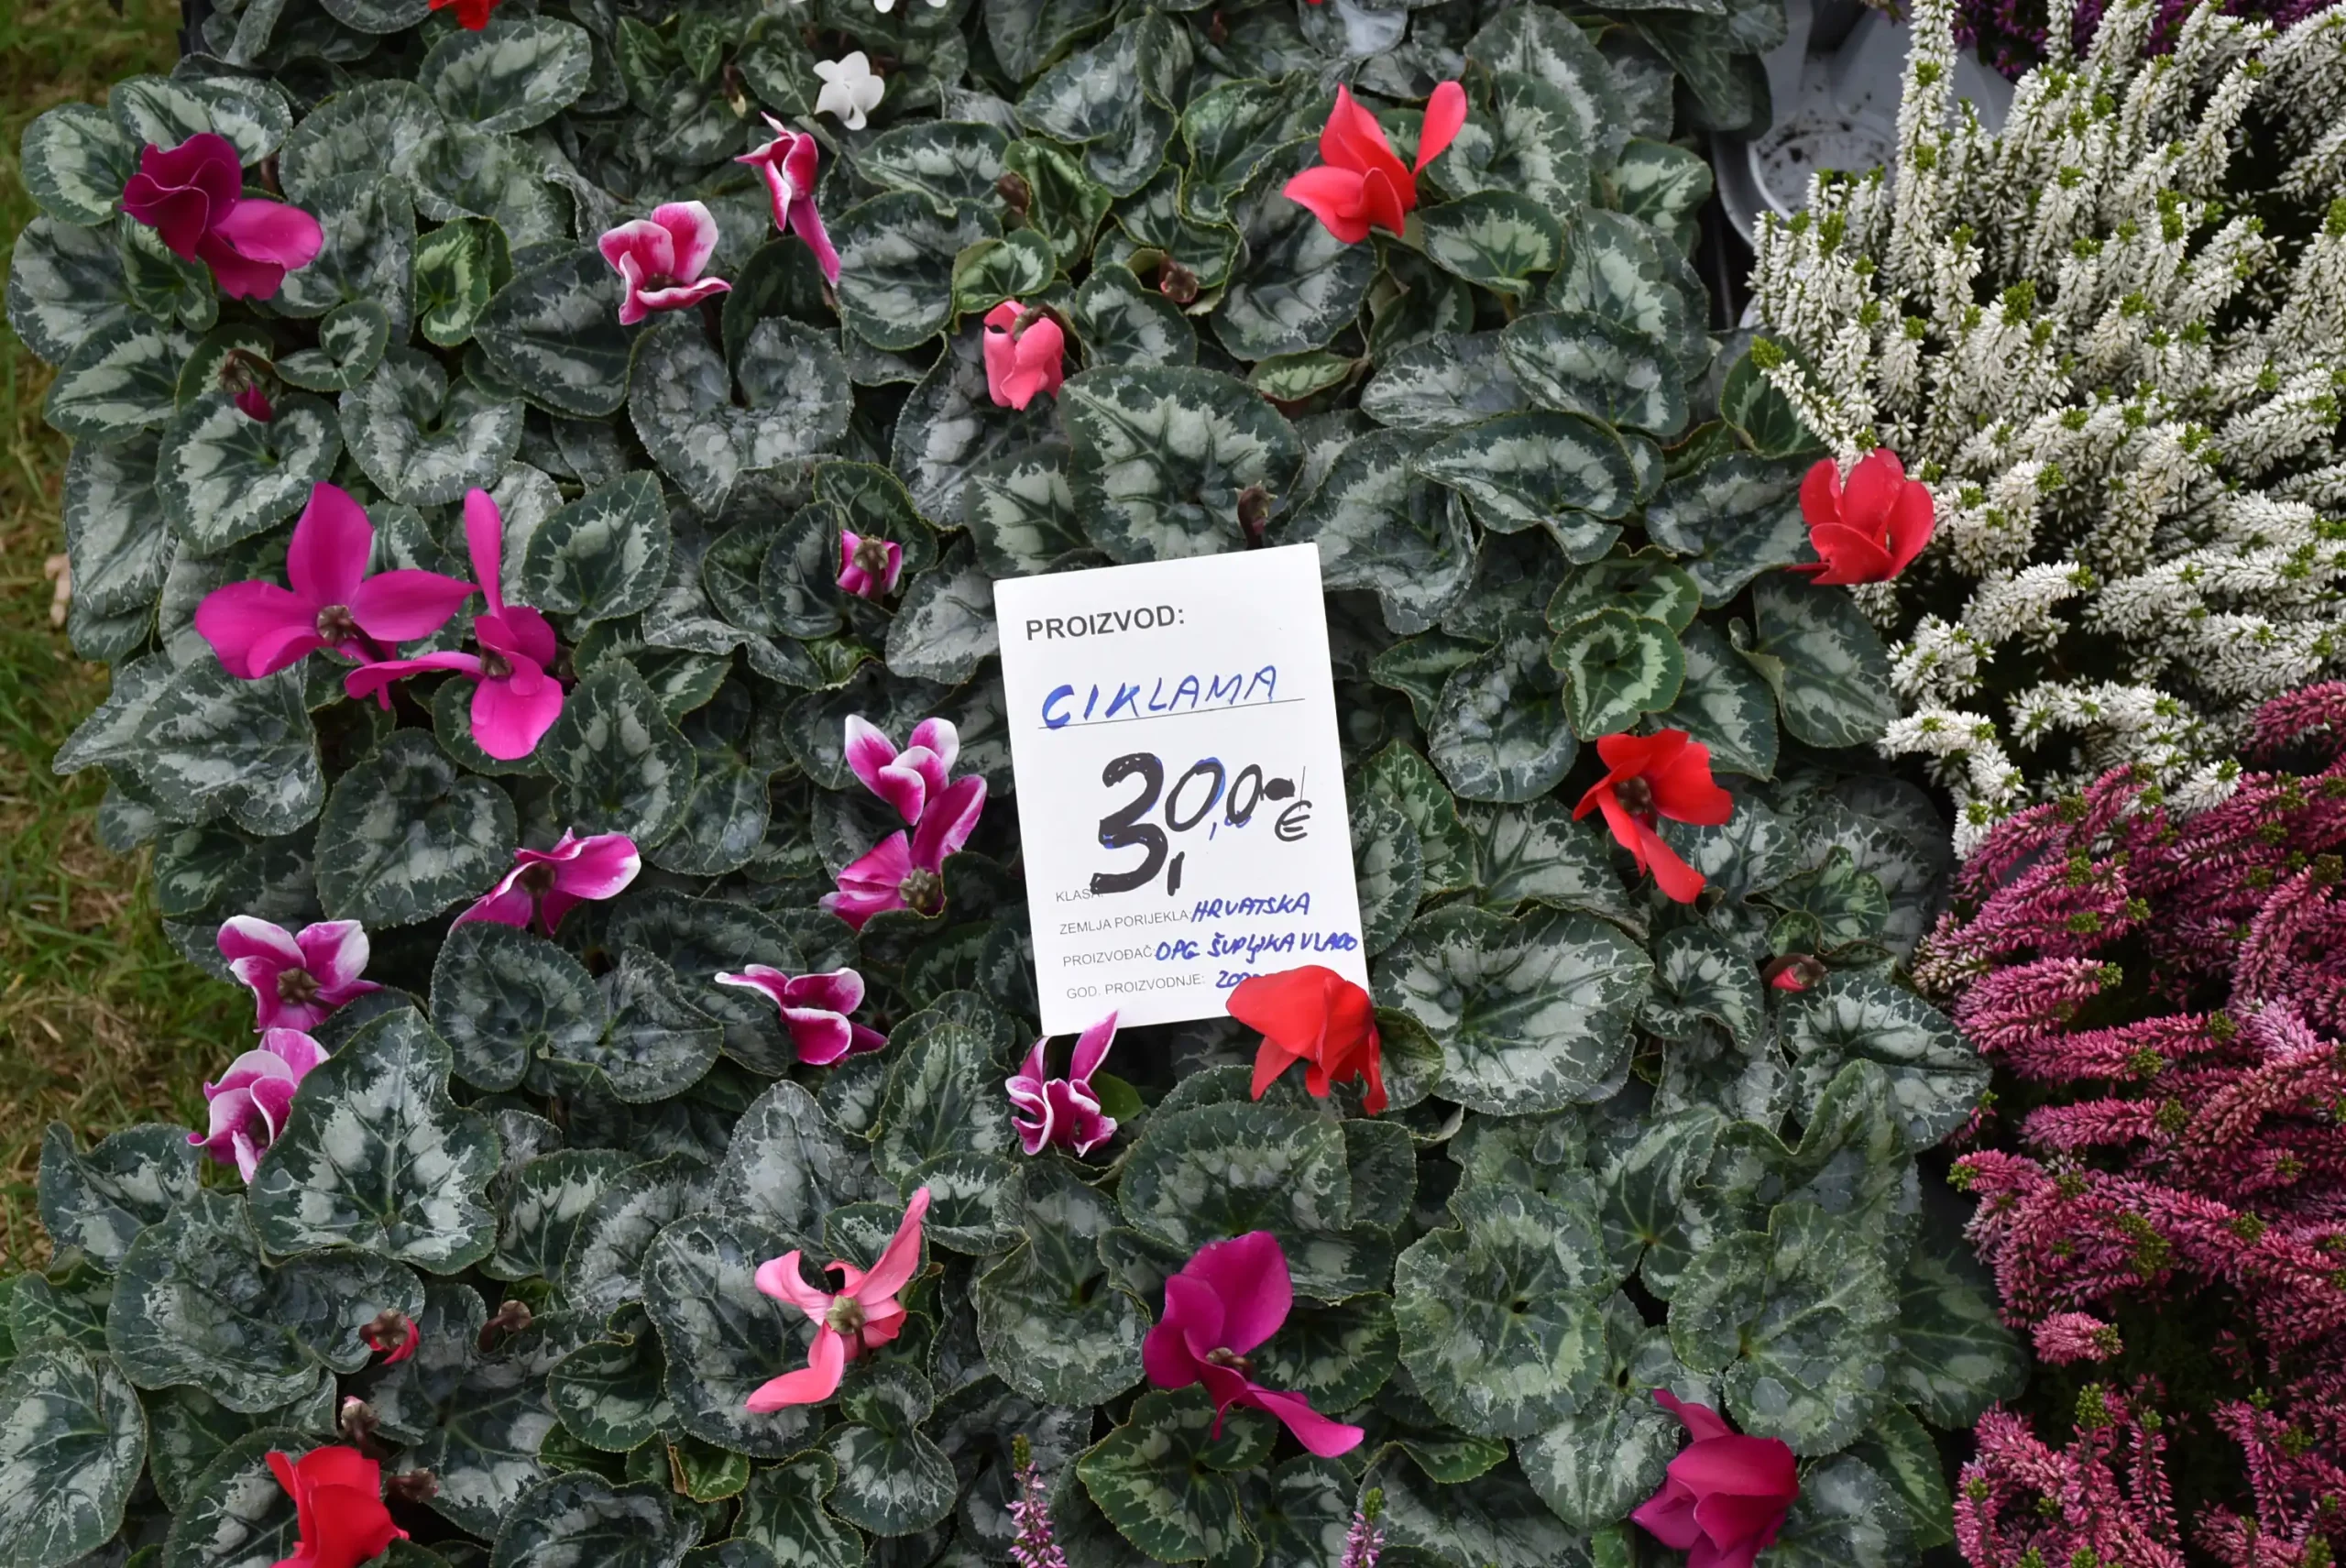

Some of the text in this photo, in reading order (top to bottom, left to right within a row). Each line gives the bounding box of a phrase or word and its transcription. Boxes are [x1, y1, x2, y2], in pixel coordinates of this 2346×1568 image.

[1025, 605, 1185, 641] PROIZVOD:
[1041, 664, 1277, 730] CIKLAMA
[1059, 919, 1113, 935] ZEMLJA
[1190, 892, 1310, 923] HRVATSKA
[1063, 945, 1156, 967] PROIZVOĐAČ:
[1155, 939, 1200, 960] OPG
[1067, 985, 1102, 999] GOD.
[1104, 973, 1206, 995] PROIZVODNJE:
